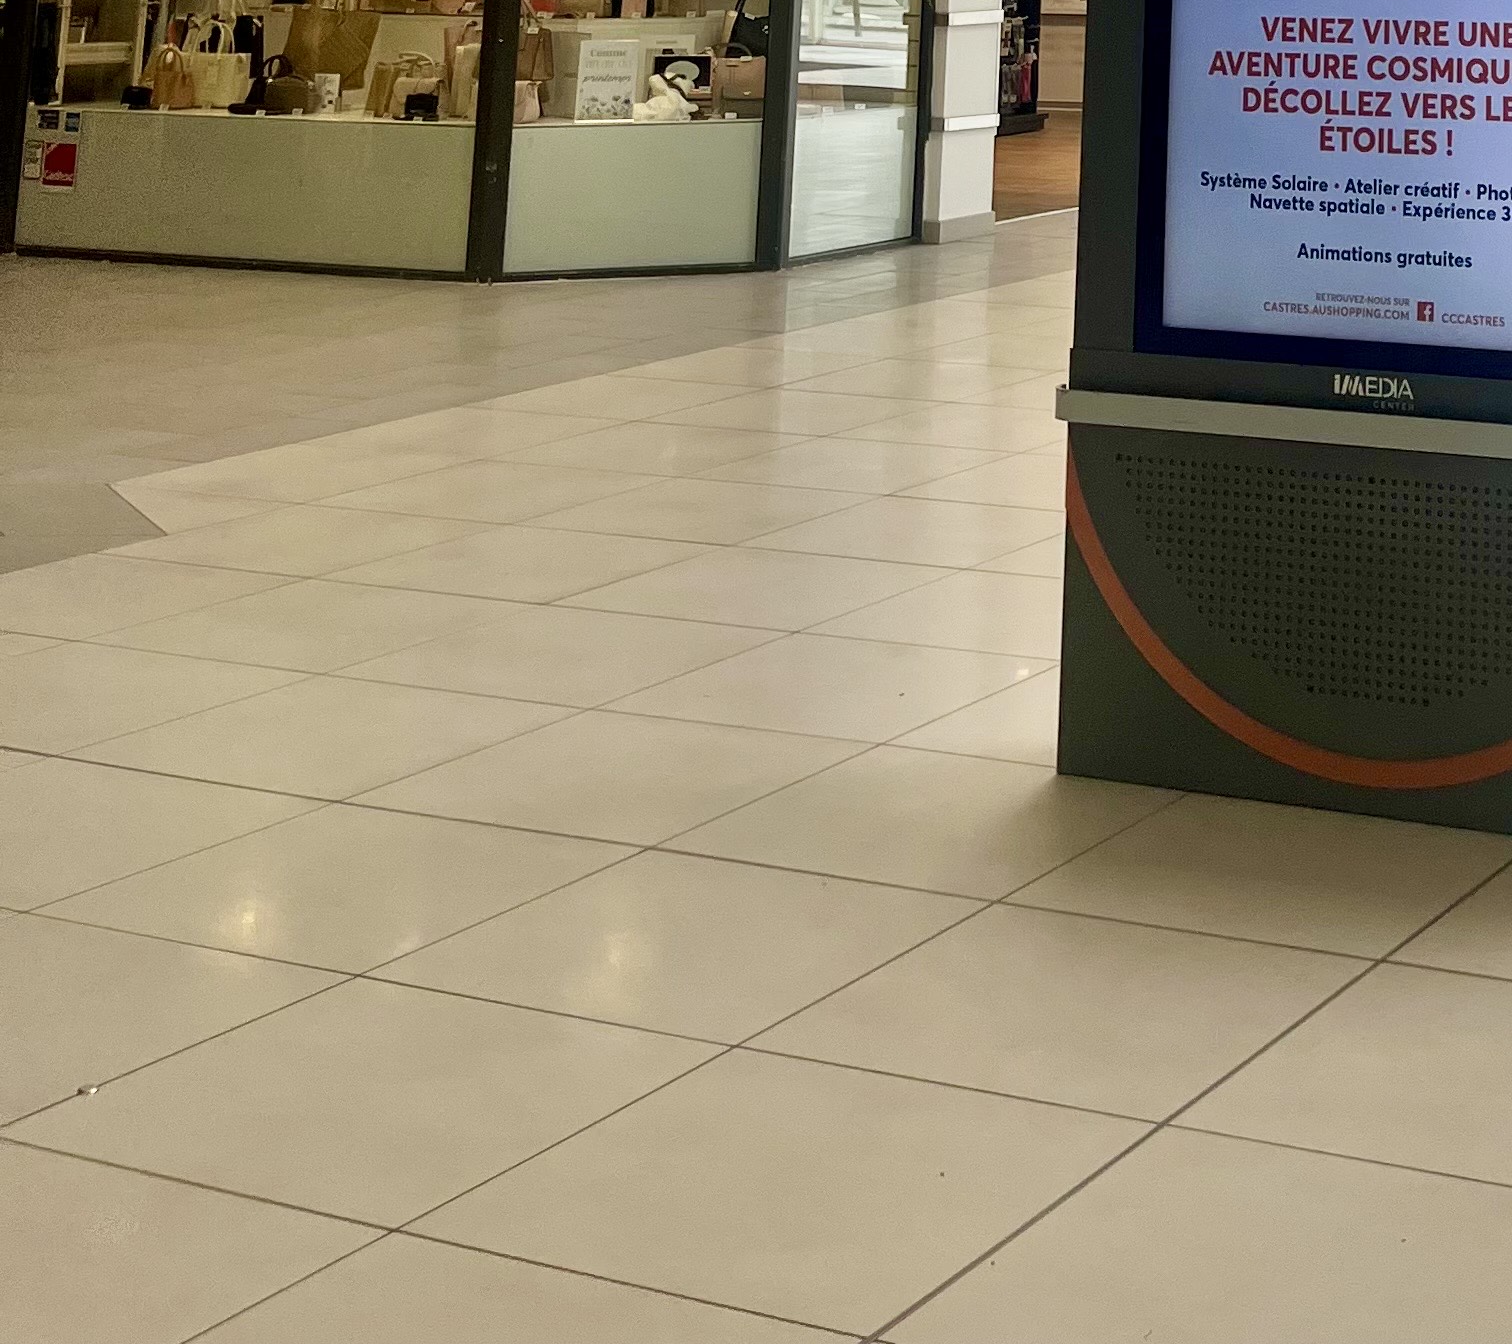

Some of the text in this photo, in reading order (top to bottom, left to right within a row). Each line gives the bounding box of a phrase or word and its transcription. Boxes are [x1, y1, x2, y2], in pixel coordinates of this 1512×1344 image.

[1261, 16, 1354, 44] VENEZ
[1363, 18, 1449, 47] VIVRE
[1208, 51, 1358, 80] AVENTURE
[1242, 80, 1392, 117] DÉCOLLEZ
[1401, 92, 1476, 121] VERS
[1319, 119, 1454, 156] ÉTOILES !
[1200, 171, 1267, 195] Système
[1271, 174, 1328, 193] Solaire
[1344, 178, 1400, 197] Atelier
[1404, 181, 1460, 199] créatif
[1250, 194, 1315, 212] Navette
[1318, 197, 1386, 216] spatiale
[1402, 201, 1497, 221] Expérience
[1297, 243, 1473, 269] Animations gratuites
[1263, 301, 1410, 321] CASTRES.AUSHOPPING.COM
[1316, 292, 1411, 306] RETROUVEZ-NOUS SUR
[1441, 313, 1505, 327] CCCASTRES
